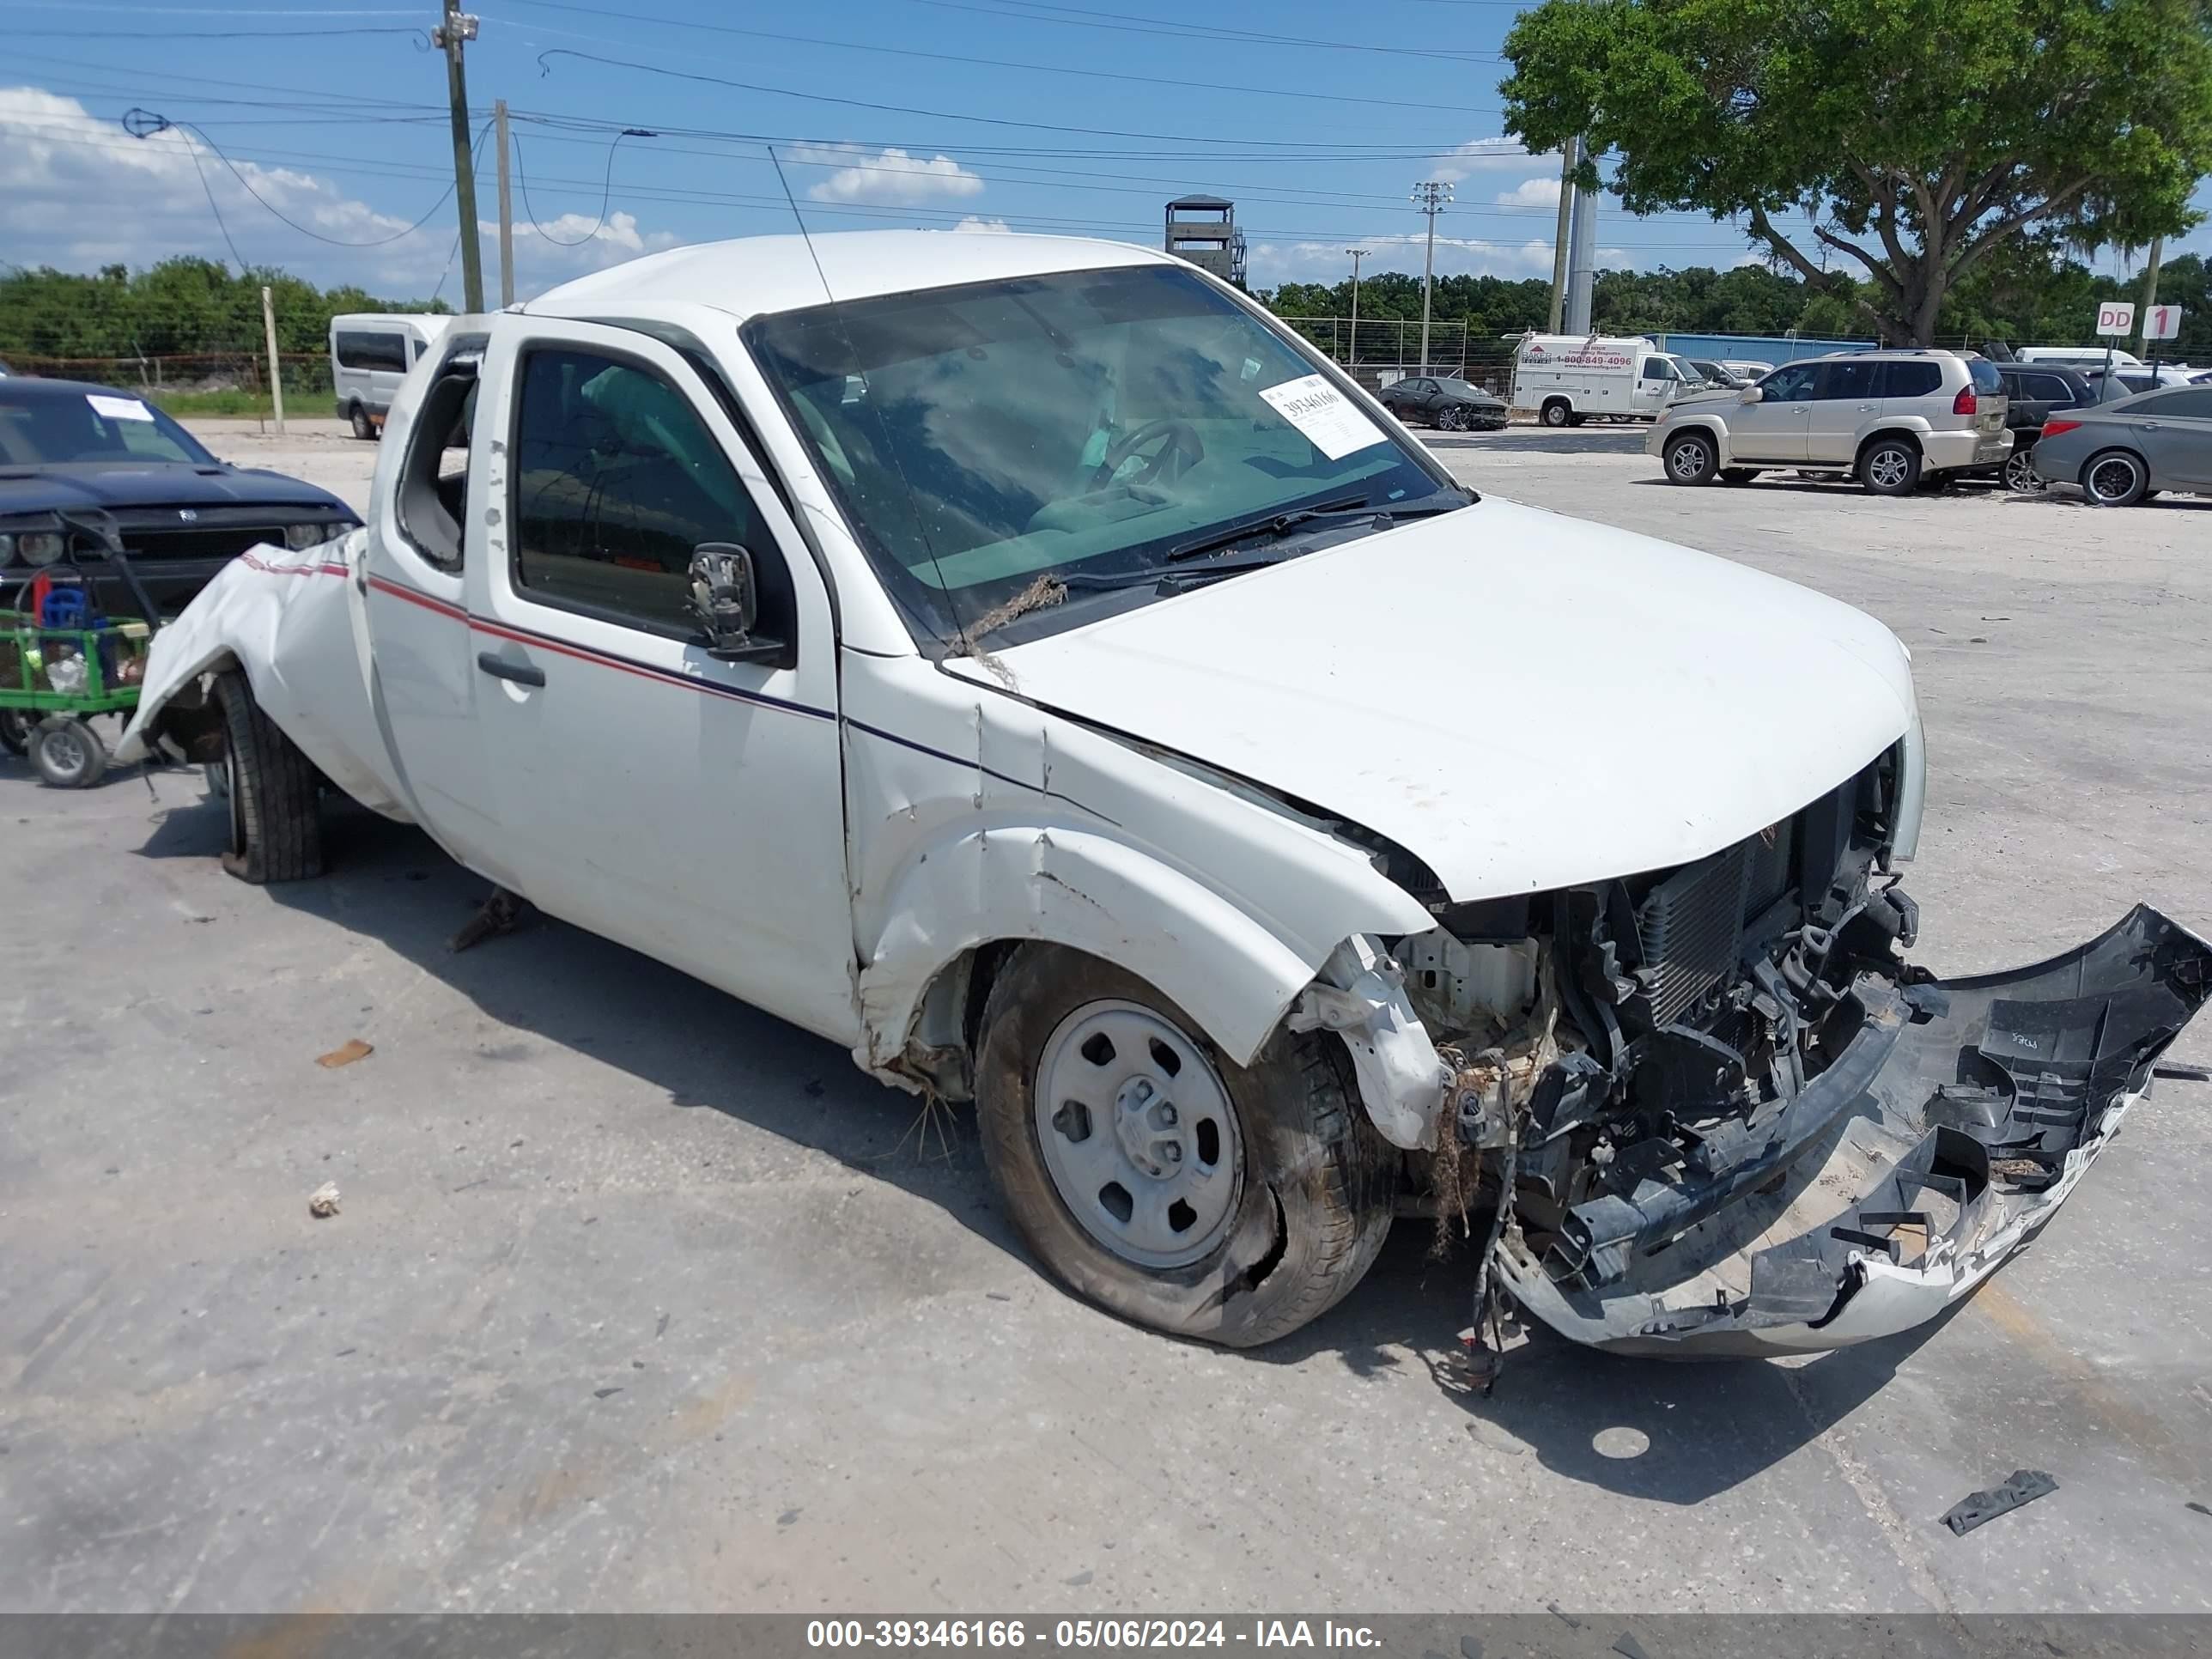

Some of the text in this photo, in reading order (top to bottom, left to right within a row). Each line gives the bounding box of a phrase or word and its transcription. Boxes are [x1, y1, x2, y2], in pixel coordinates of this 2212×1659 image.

[2100, 311, 2131, 327] DD
[2155, 307, 2168, 335] 1
[1556, 356, 1632, 365] 1-800-849-4096
[1283, 389, 1340, 417] 39346166
